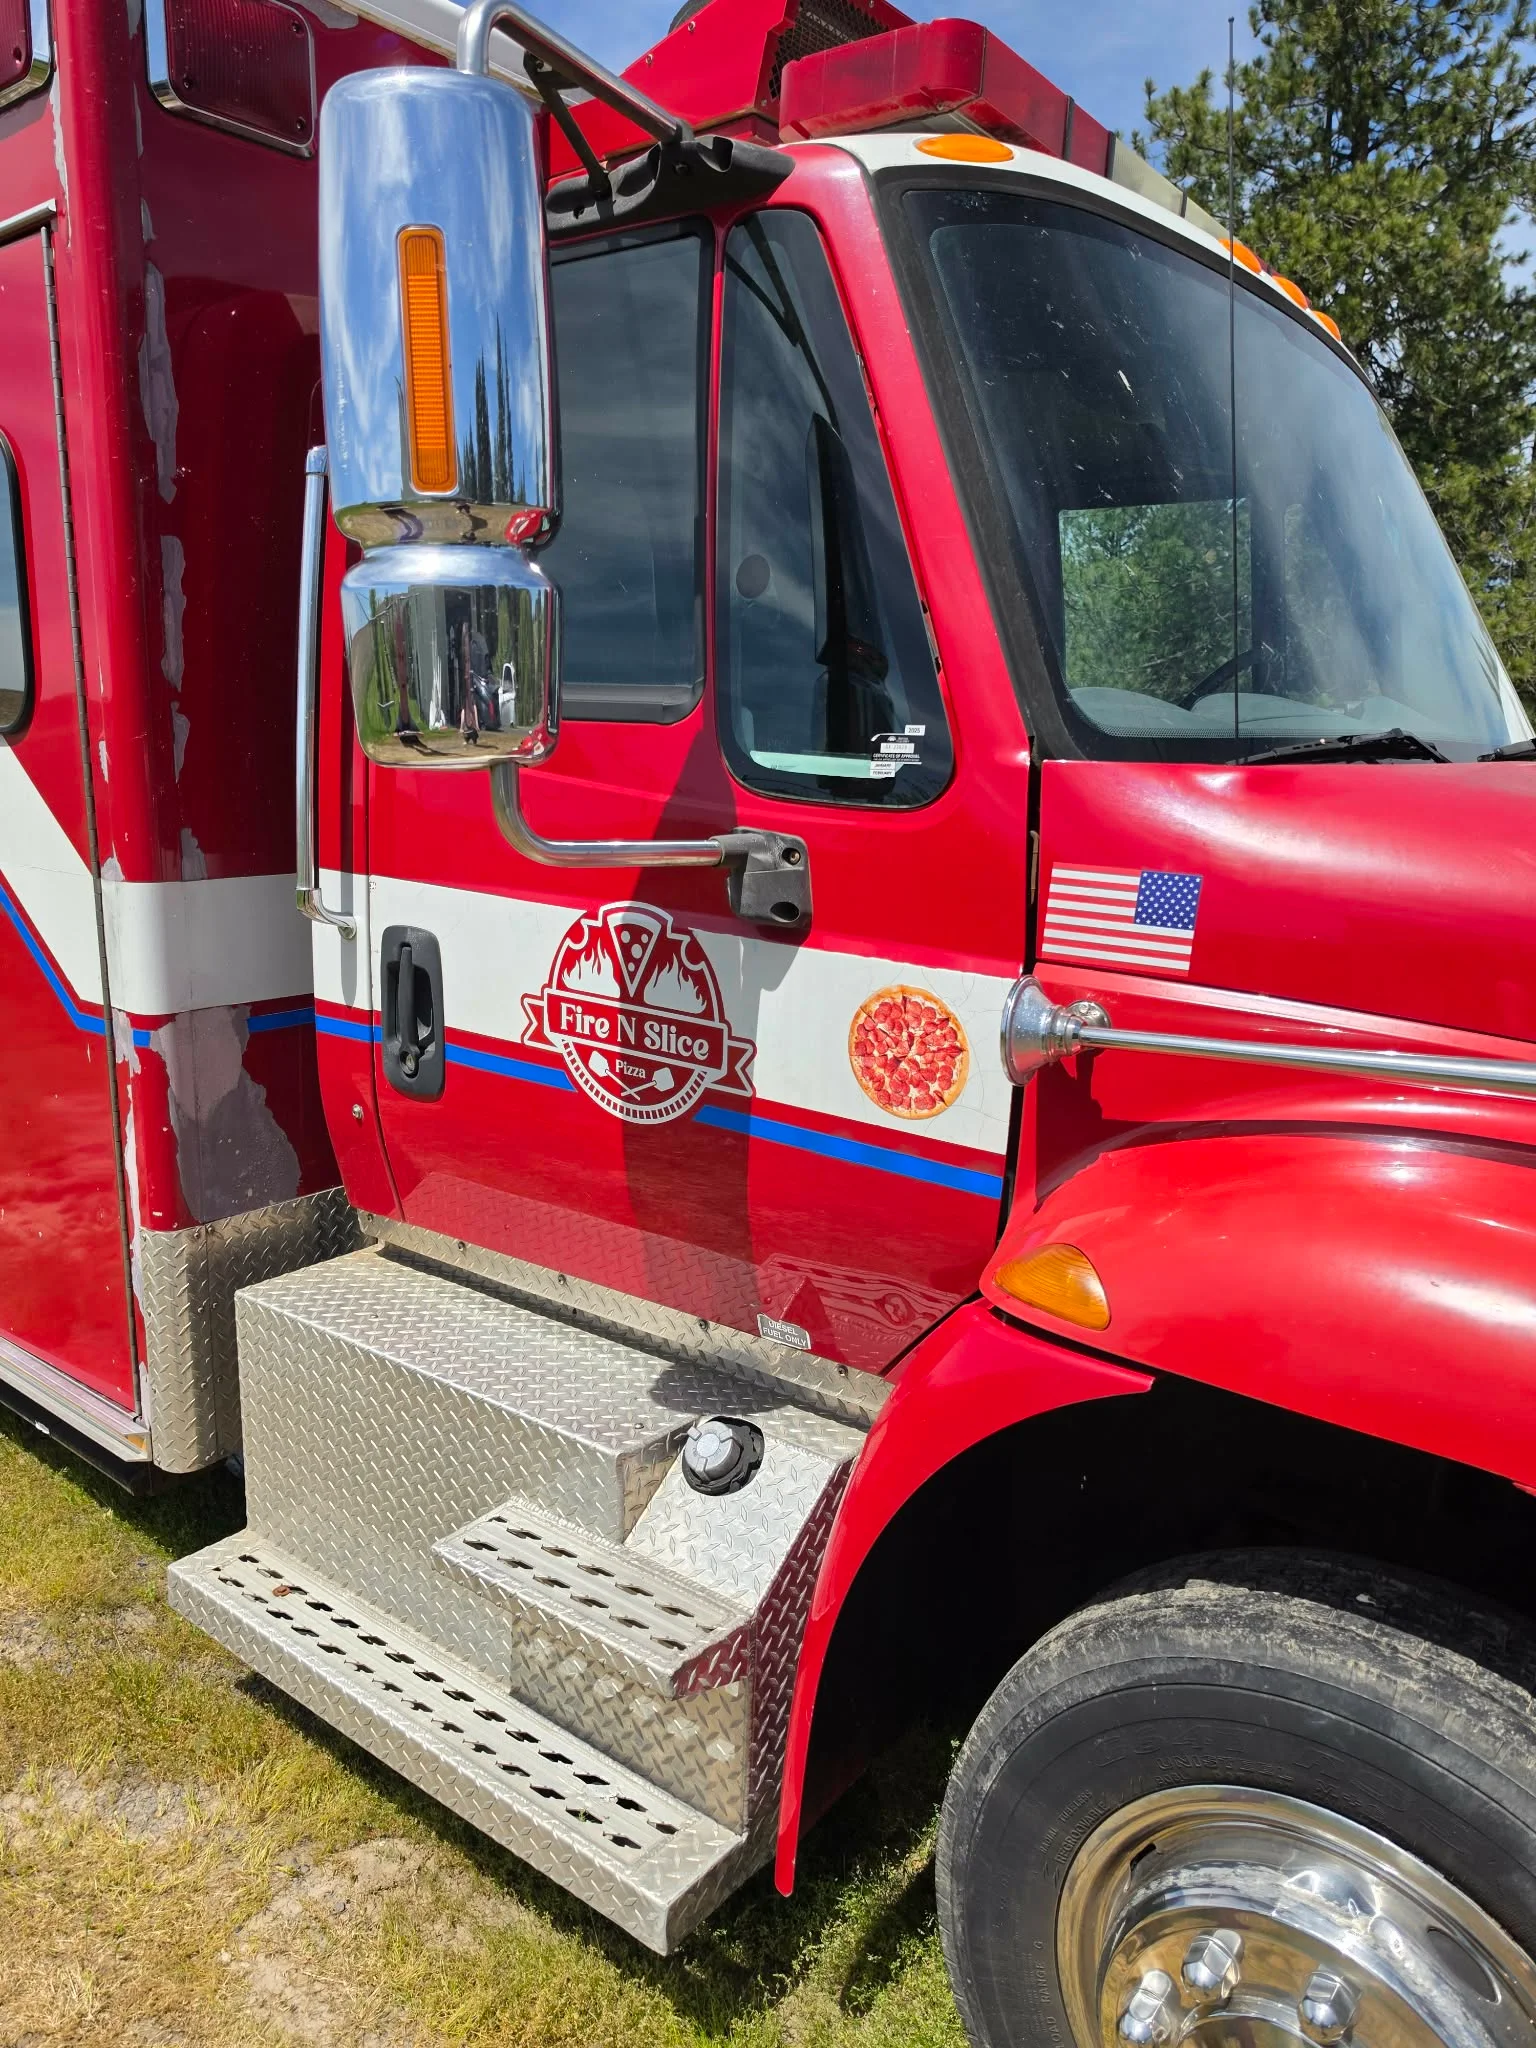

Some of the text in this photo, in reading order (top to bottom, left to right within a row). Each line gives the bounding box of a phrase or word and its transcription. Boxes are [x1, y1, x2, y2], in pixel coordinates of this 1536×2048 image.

[560, 1002, 710, 1060] Fire N Slice
[615, 1058, 646, 1079] Pizza
[762, 1326, 807, 1347] FUEL ONLY
[768, 1320, 799, 1336] DIESEL
[1154, 1755, 1296, 1782] UNISTEEL
[1055, 1800, 1109, 1865] REGROOVABLE
[1034, 1961, 1053, 2004] RANGE
[1046, 2015, 1065, 2048] LOAD
